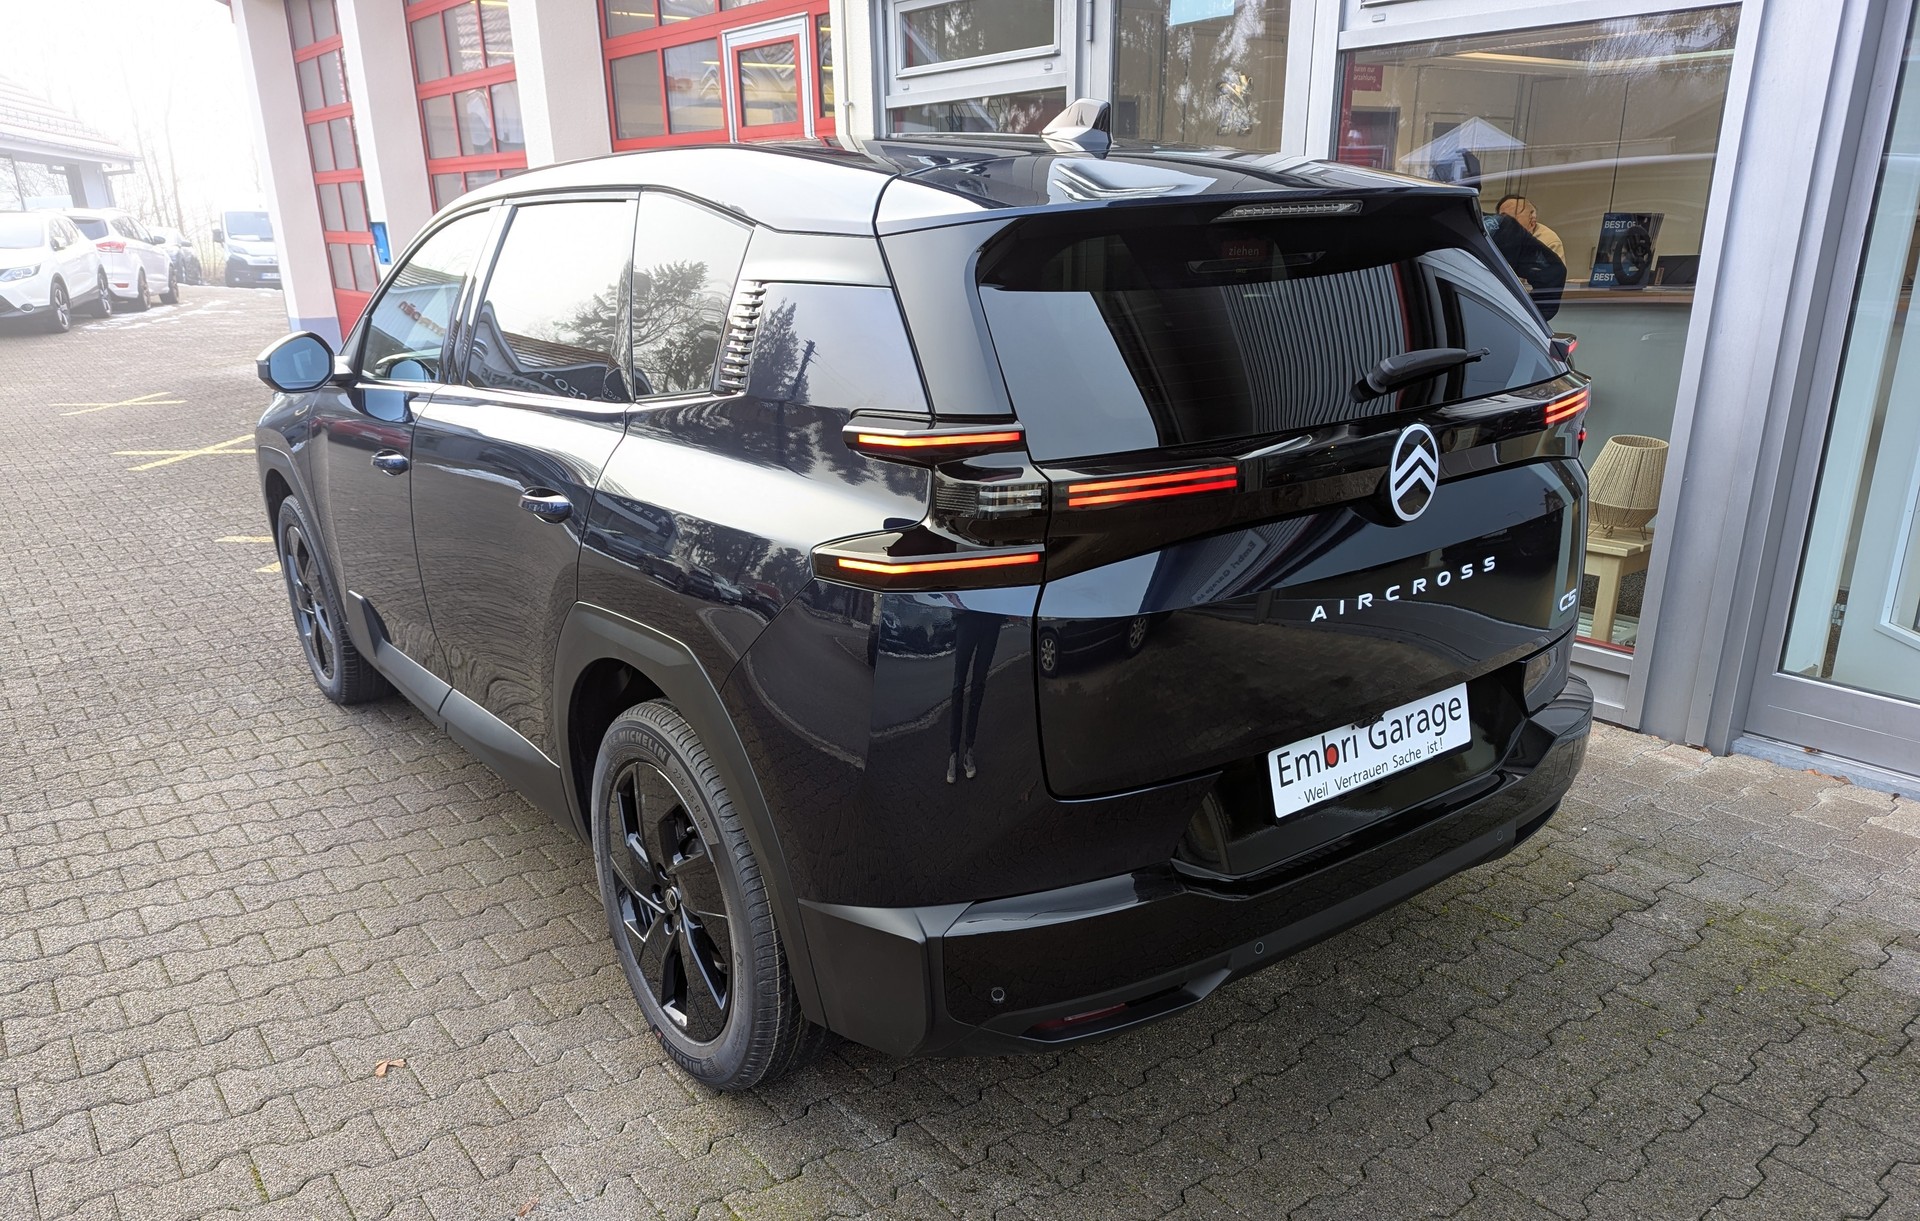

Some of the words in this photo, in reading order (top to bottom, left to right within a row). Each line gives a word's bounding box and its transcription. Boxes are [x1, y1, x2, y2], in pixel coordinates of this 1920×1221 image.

[1604, 220, 1626, 229] BEST
[1229, 245, 1259, 256] ziehen
[1593, 273, 1615, 282] BEST
[1310, 556, 1496, 622] AIRCROSS
[1558, 588, 1577, 612] C5
[619, 730, 669, 763] MICHELIN
[1277, 724, 1359, 788] Embri
[1368, 697, 1462, 750] Garage
[1304, 781, 1329, 804] Weil
[1334, 760, 1389, 791] Vertrauen
[1393, 748, 1422, 769] Sache
